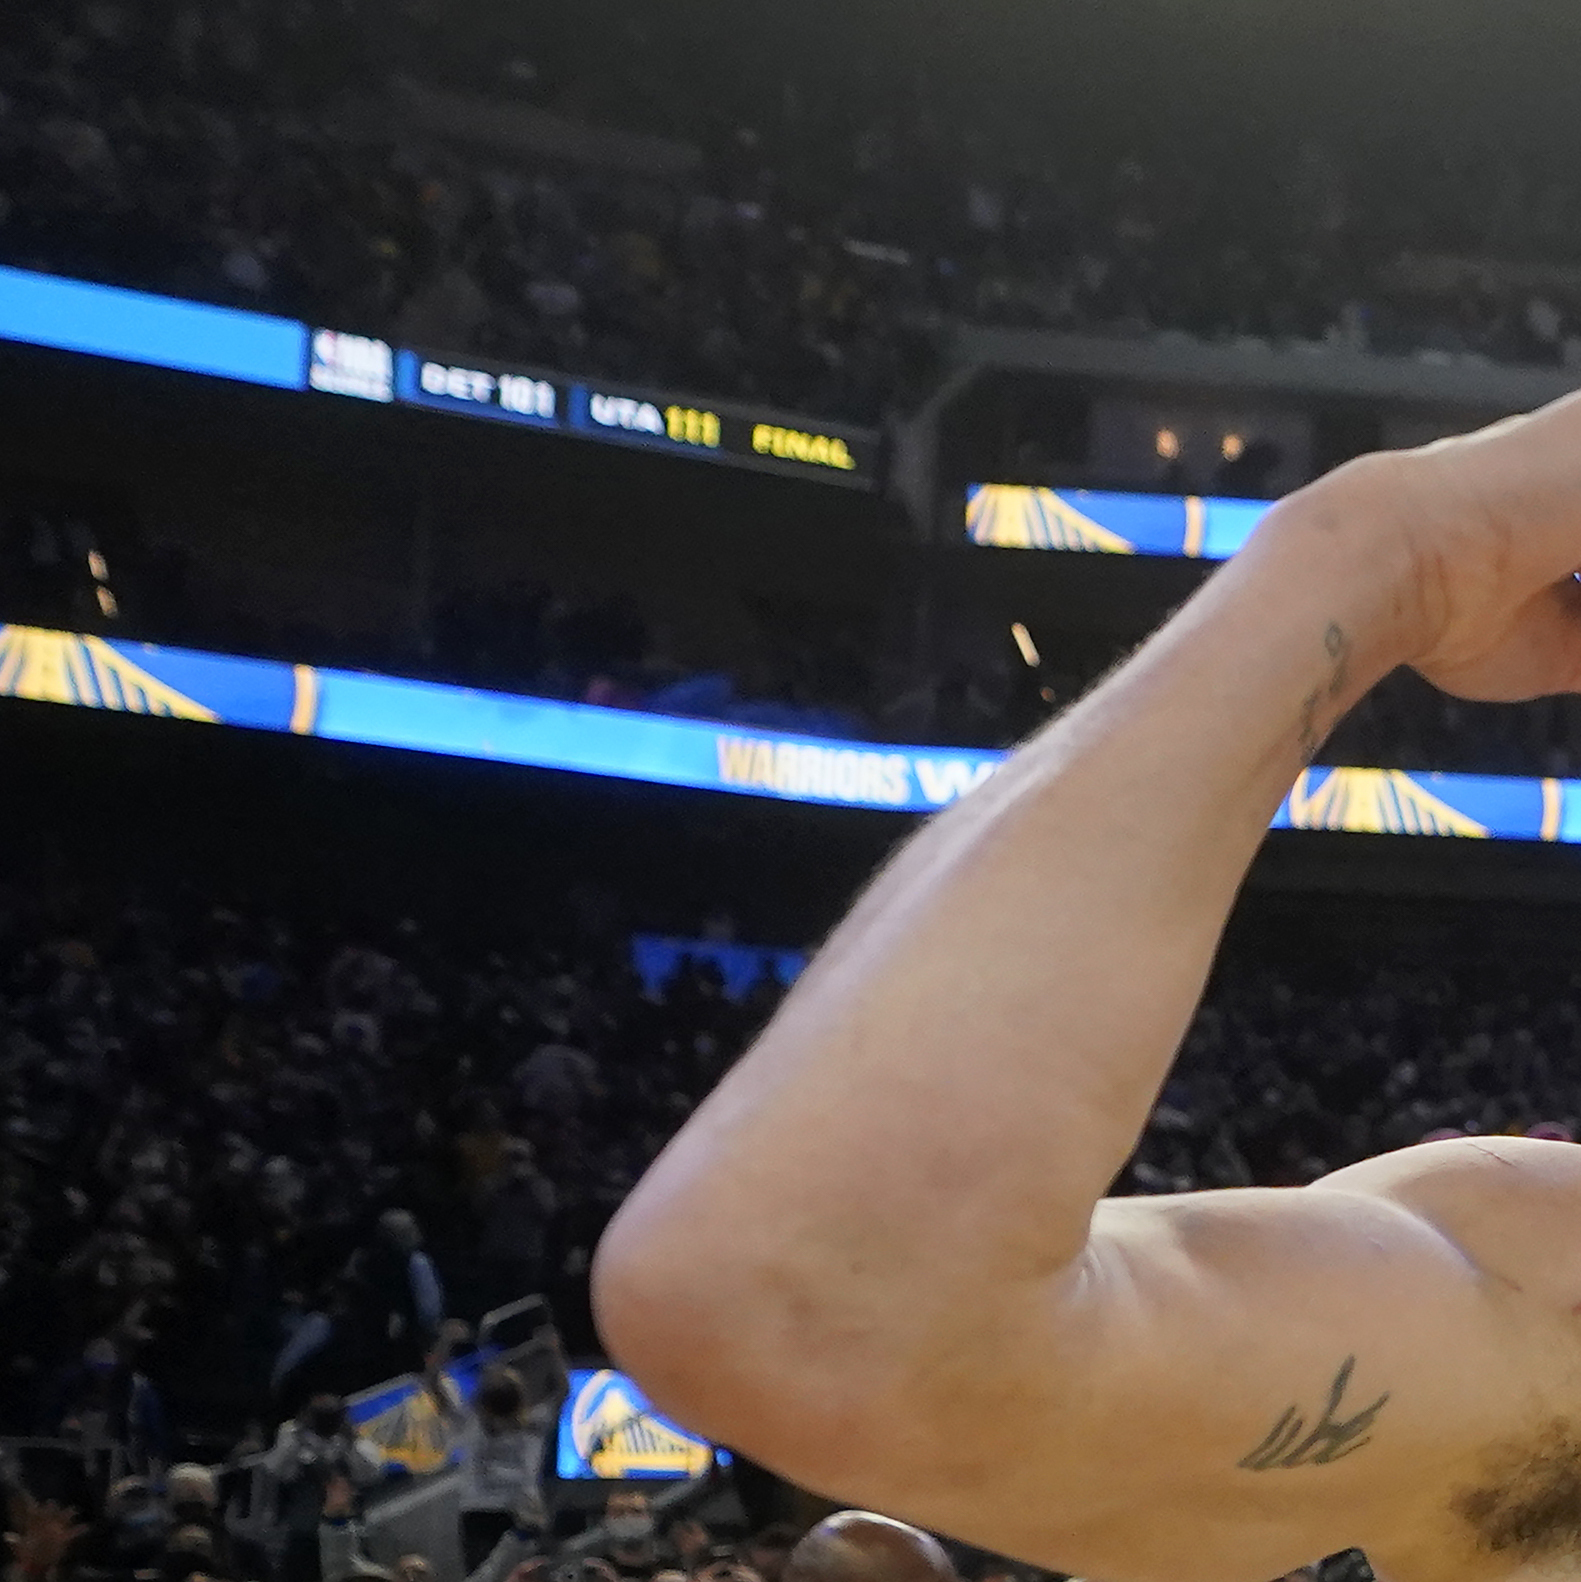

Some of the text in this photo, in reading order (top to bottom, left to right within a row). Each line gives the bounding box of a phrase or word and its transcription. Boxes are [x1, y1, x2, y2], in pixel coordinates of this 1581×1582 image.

[420, 362, 496, 403] DET
[498, 373, 556, 419] 101
[590, 393, 665, 436] UTA
[752, 423, 855, 471] FINAL
[717, 734, 910, 804] WARRIORS
